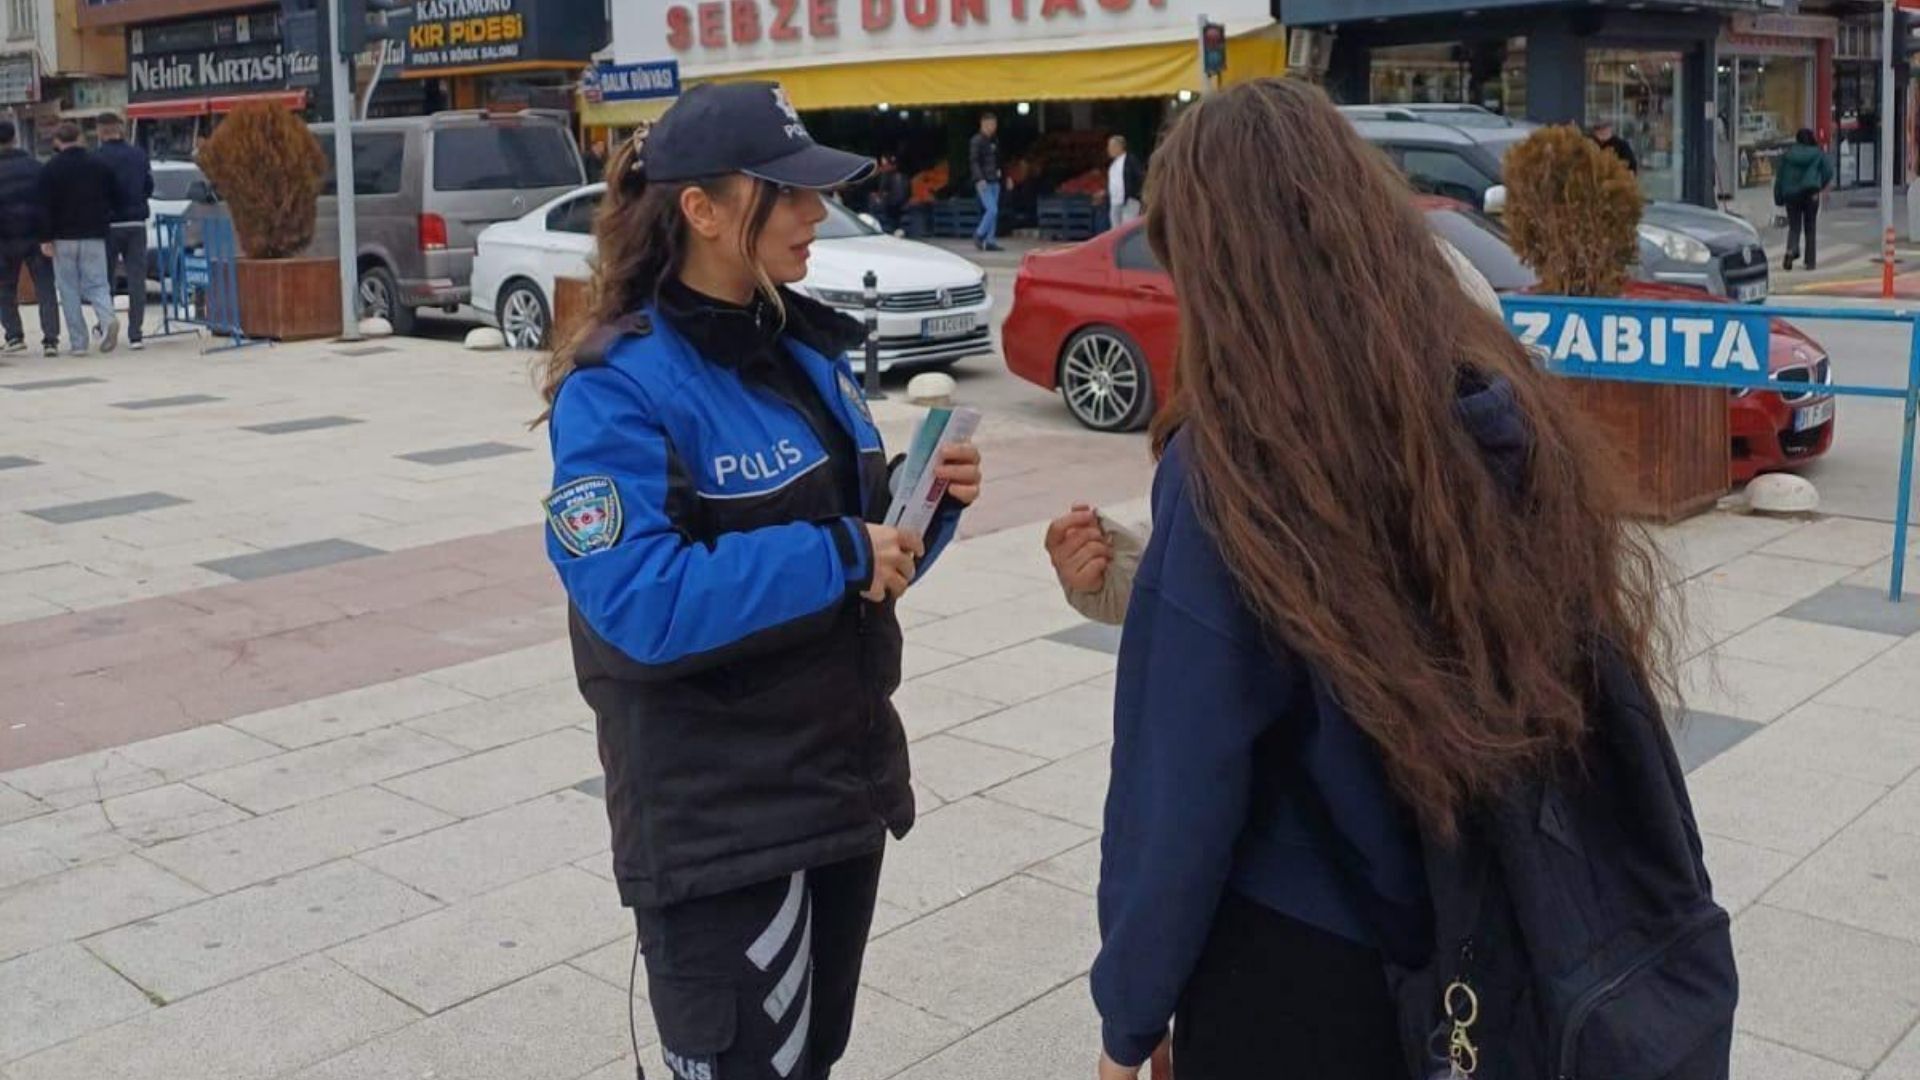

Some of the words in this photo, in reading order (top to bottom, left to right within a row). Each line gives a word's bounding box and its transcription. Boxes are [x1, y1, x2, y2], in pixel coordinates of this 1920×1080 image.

[409, 24, 445, 48] KIR
[665, 0, 839, 52] SEBZE
[1512, 311, 1760, 371] ZABITA
